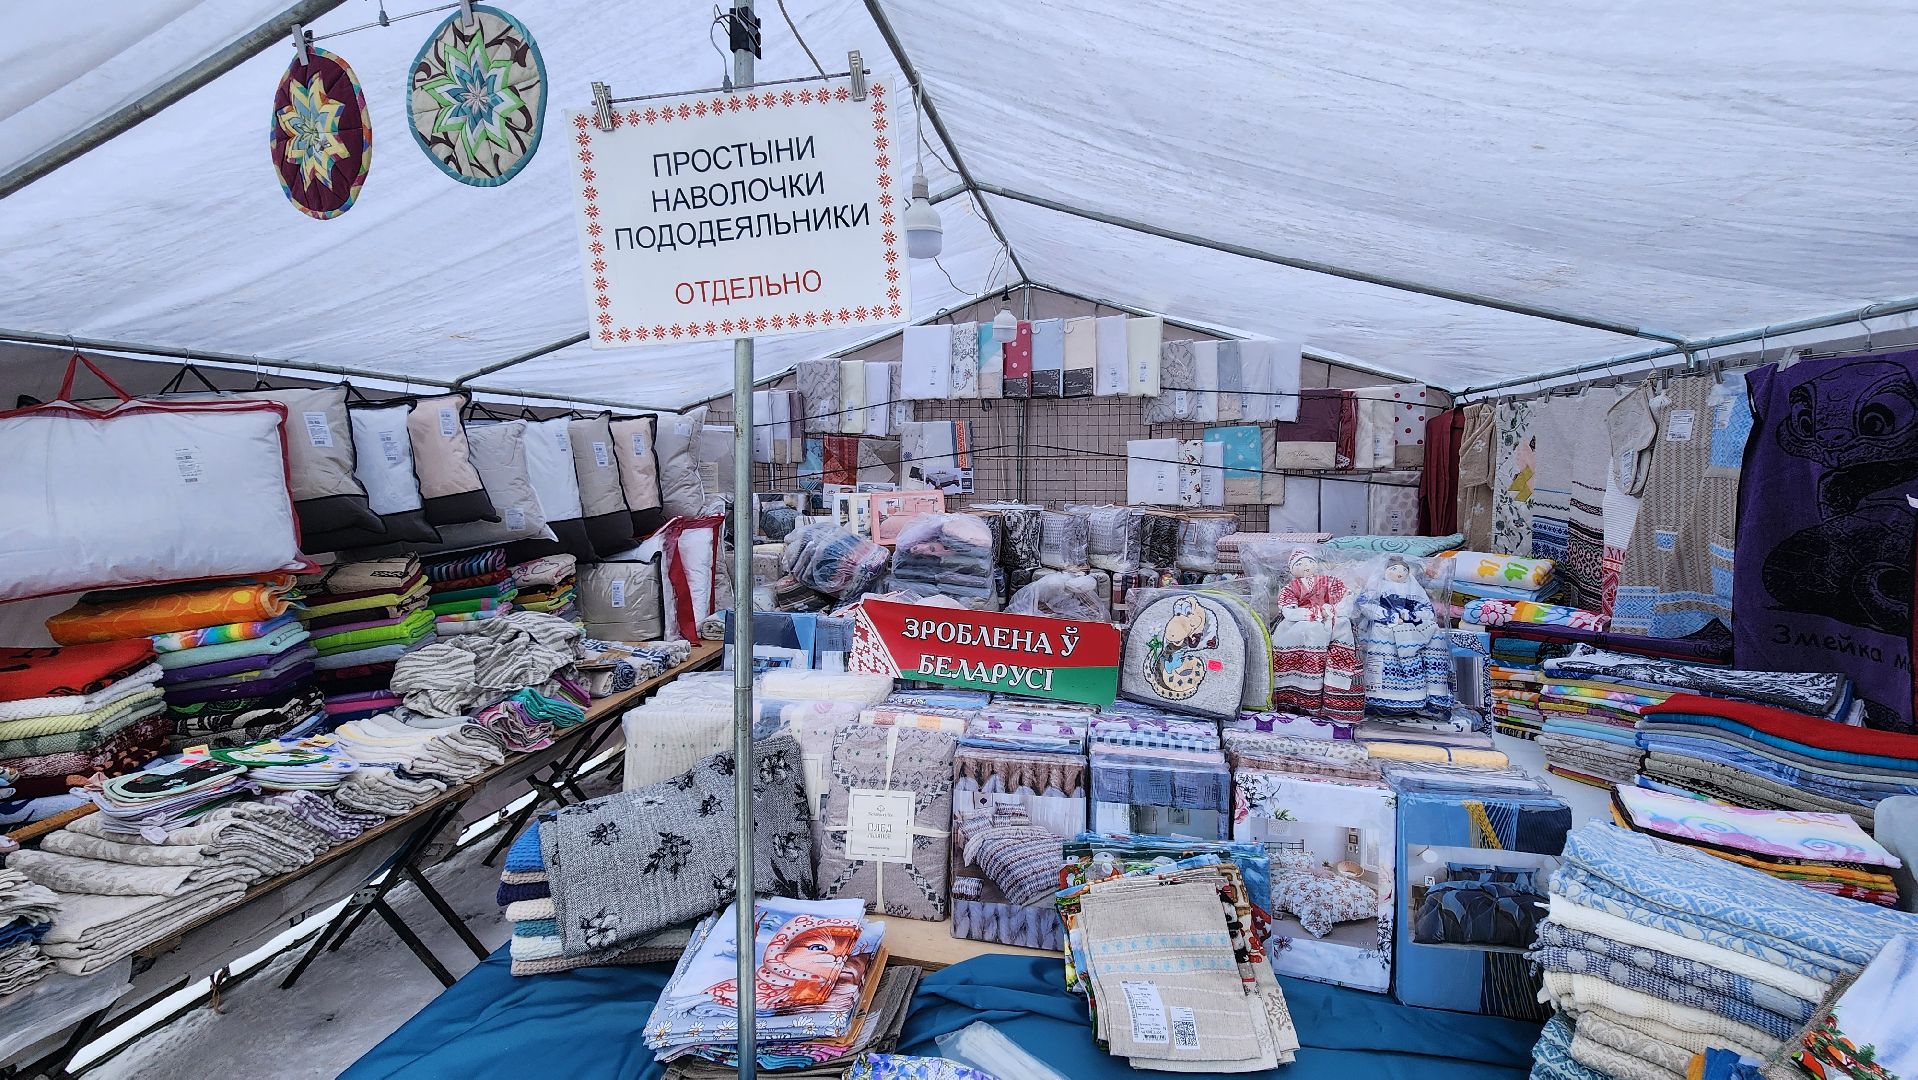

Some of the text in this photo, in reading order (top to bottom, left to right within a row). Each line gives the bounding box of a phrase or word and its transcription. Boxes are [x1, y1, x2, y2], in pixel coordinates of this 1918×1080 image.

[652, 135, 815, 177] ПРОСТЫНИ
[651, 171, 825, 213] НАВОЛОЧКИ
[614, 202, 870, 252] ПОДОДЕЯЛЬНИКИ
[675, 269, 822, 306] ОТДЕЛЬНО
[901, 618, 1080, 657] ЗРОБЛЕНА Ў
[1771, 623, 1883, 664] Змейка
[917, 653, 1054, 691] БЕЛАРУСІ
[867, 822, 892, 833] ПЛЕД
